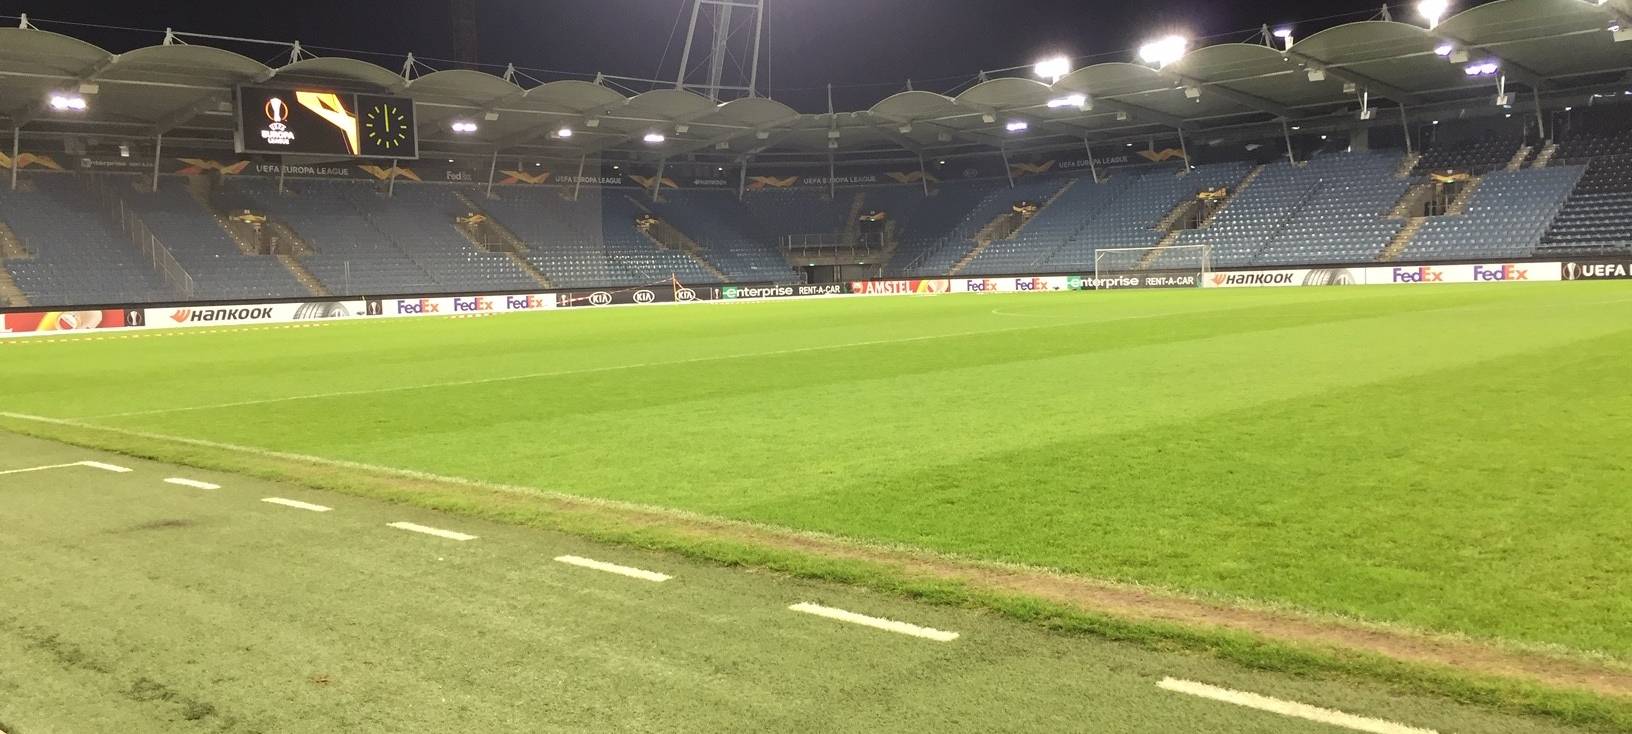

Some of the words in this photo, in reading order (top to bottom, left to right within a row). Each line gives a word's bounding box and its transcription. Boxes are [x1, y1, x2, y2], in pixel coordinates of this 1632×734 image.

[256, 164, 280, 173] UEFA
[316, 167, 349, 176] LEAGUE
[1393, 266, 1443, 283] FedEx
[1474, 264, 1528, 281] FedEx
[1582, 264, 1626, 277] UEFA
[865, 280, 914, 294] AMSTEL
[967, 279, 997, 291] FedEx
[1015, 277, 1048, 291] FedEx
[1145, 276, 1195, 286] RENT-A-CAR
[799, 285, 841, 295] RENT-A-CAR
[397, 299, 439, 315] FedEx
[454, 296, 493, 312] FedEx
[507, 295, 543, 310] FedEx
